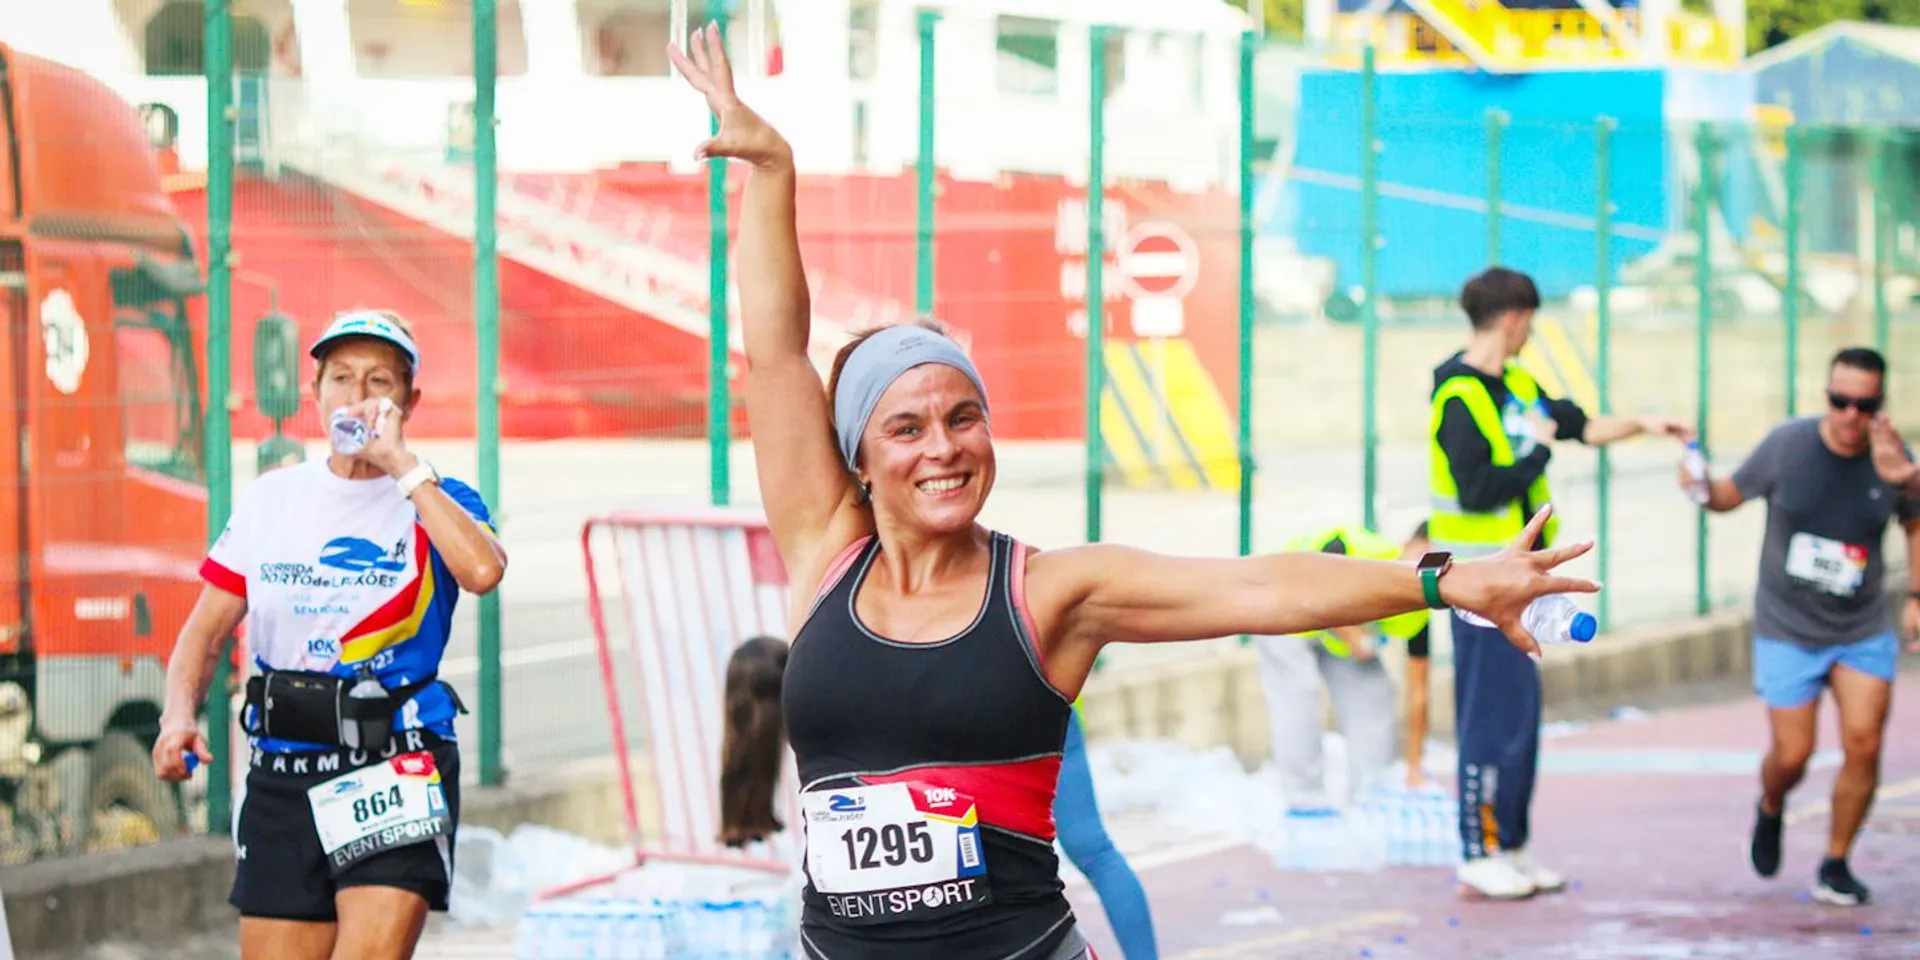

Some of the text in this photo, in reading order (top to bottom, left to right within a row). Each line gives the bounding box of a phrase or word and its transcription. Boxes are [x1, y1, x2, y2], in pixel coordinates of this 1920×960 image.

[308, 640, 336, 653] 10K
[352, 784, 404, 823] 864
[924, 788, 957, 803] 10K
[841, 821, 934, 870] 1295
